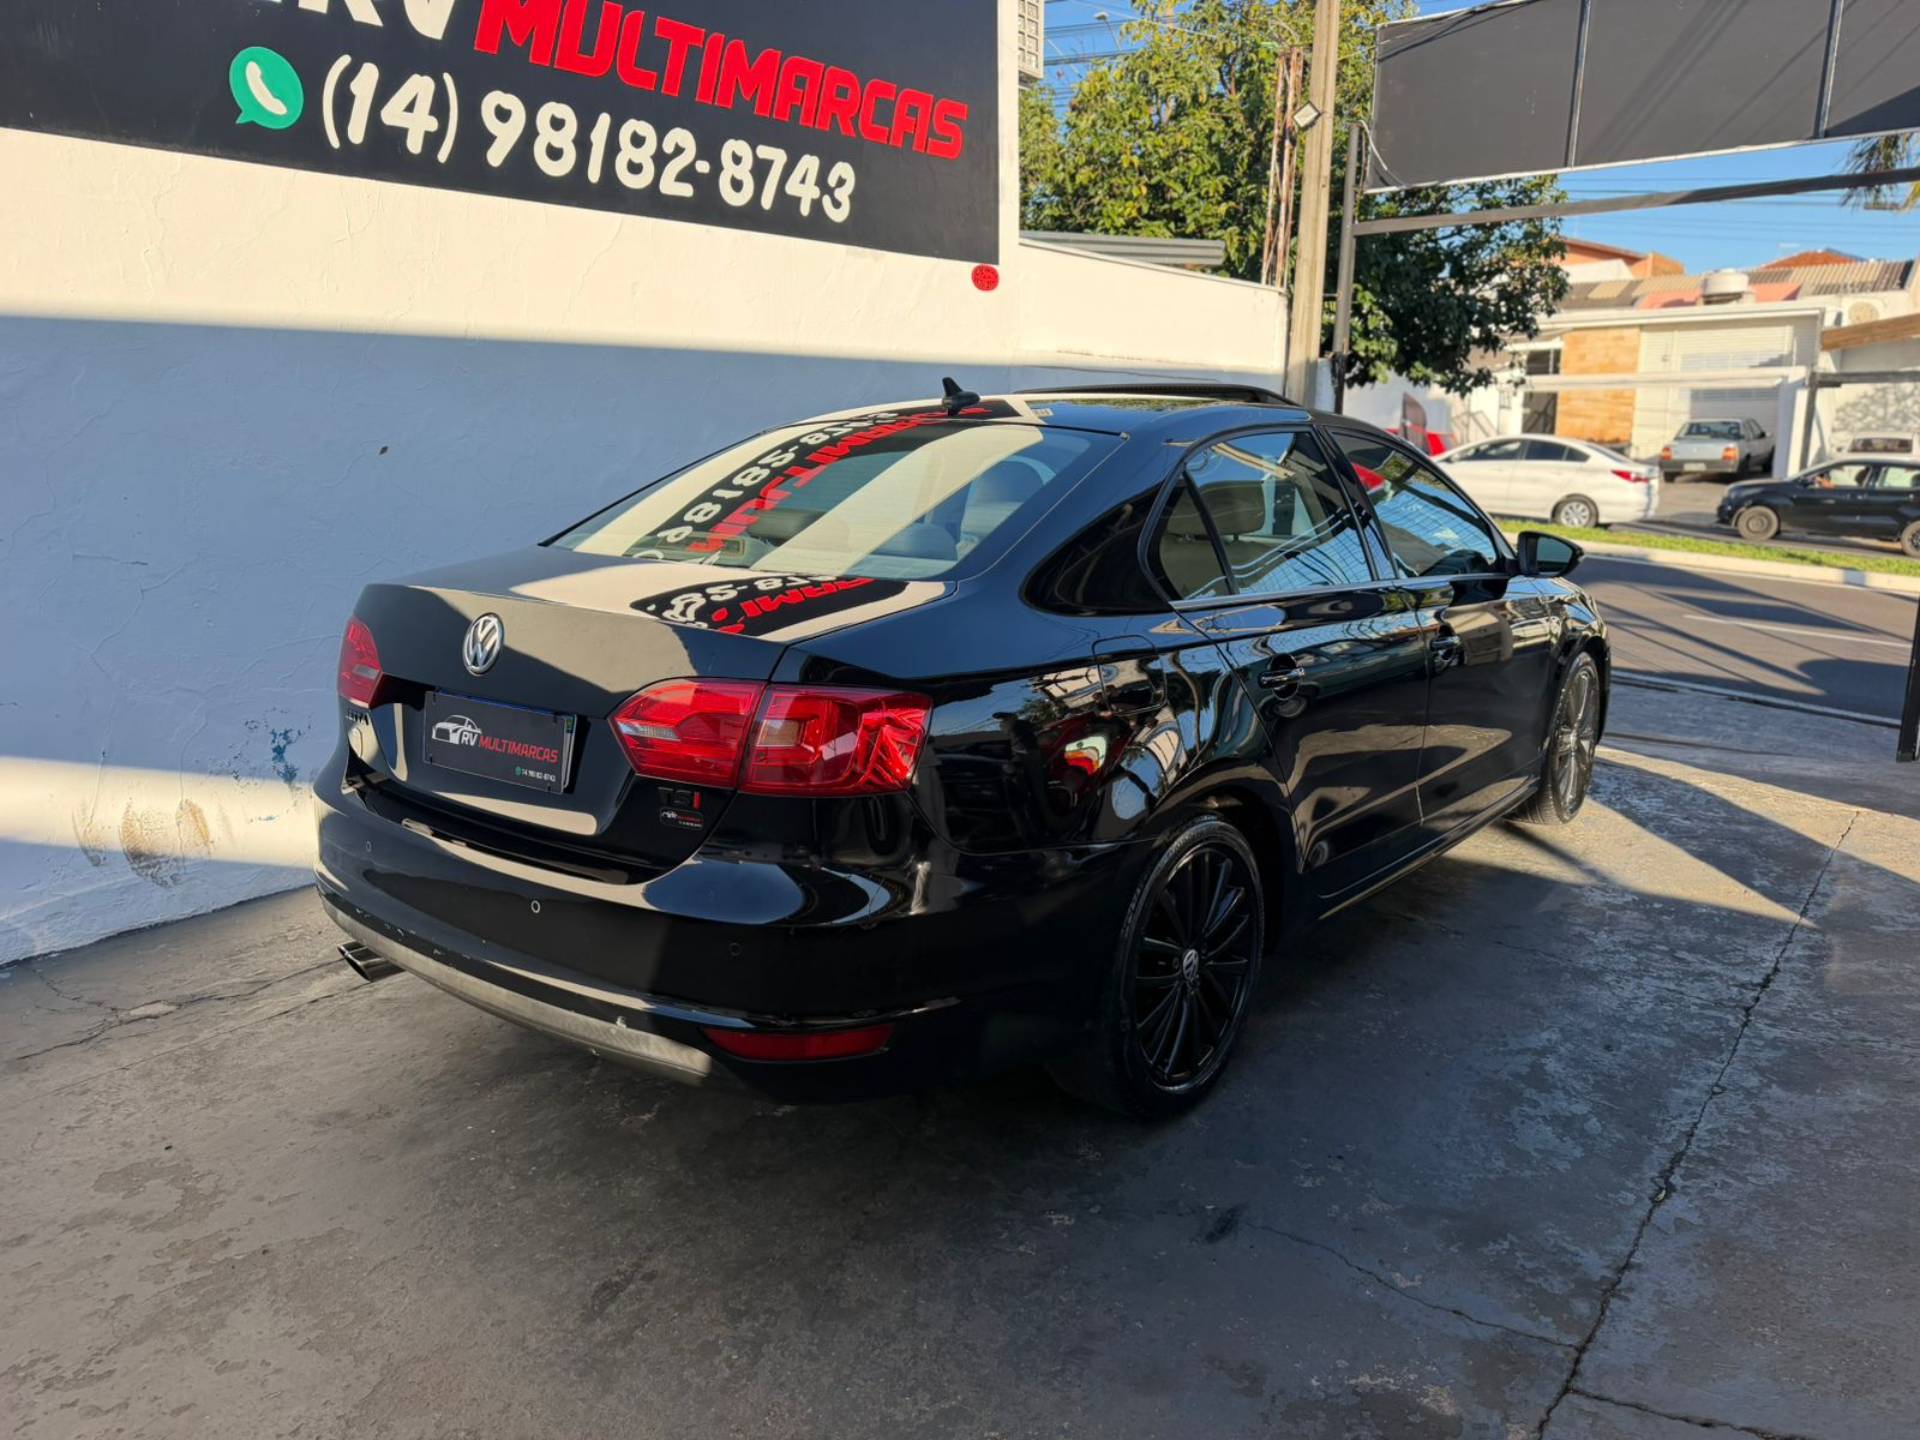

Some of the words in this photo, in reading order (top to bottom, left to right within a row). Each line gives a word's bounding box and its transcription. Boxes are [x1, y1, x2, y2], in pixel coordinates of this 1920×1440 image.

[322, 54, 459, 163] (14)
[481, 90, 856, 223] 98182-8743
[473, 0, 969, 160] MULTIMARCAS
[461, 731, 478, 746] RV
[479, 735, 559, 764] MULTIMARCAS
